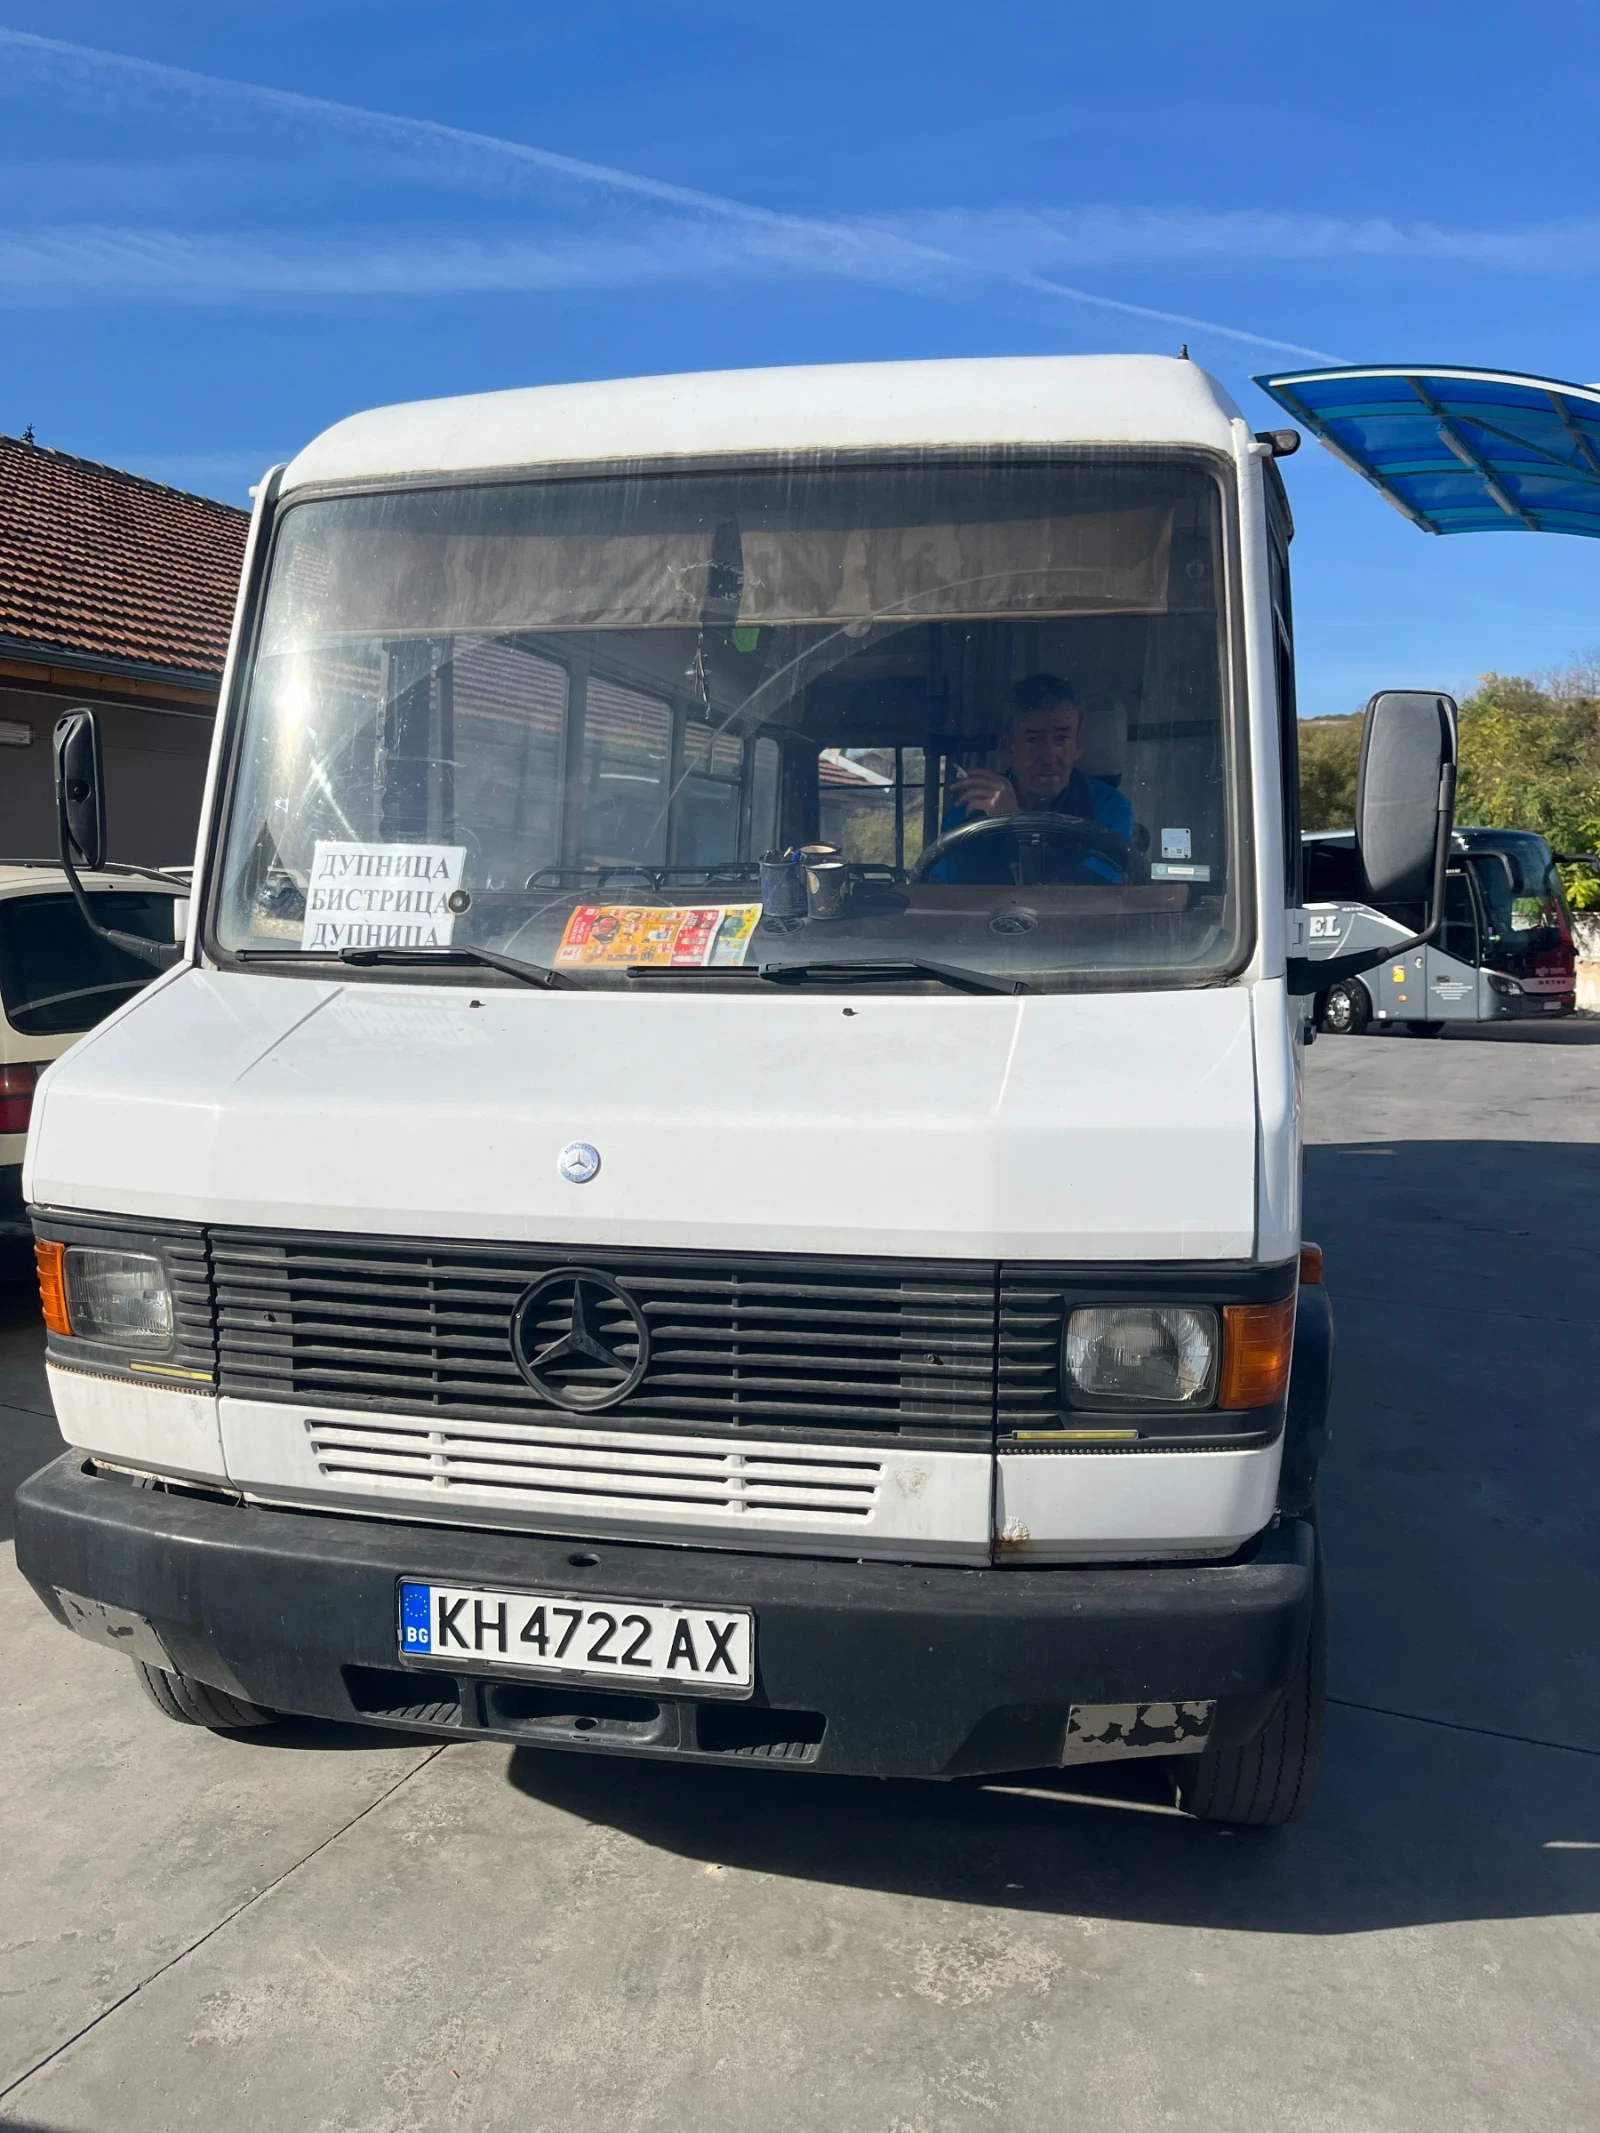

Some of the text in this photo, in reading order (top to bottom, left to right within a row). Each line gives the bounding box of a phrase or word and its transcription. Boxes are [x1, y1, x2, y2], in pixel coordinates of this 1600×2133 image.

[318, 854, 451, 884] ДУПНИЦА
[310, 888, 450, 919] БИСТРИЦА
[406, 1626, 429, 1644] BG
[520, 1605, 653, 1668] 4722
